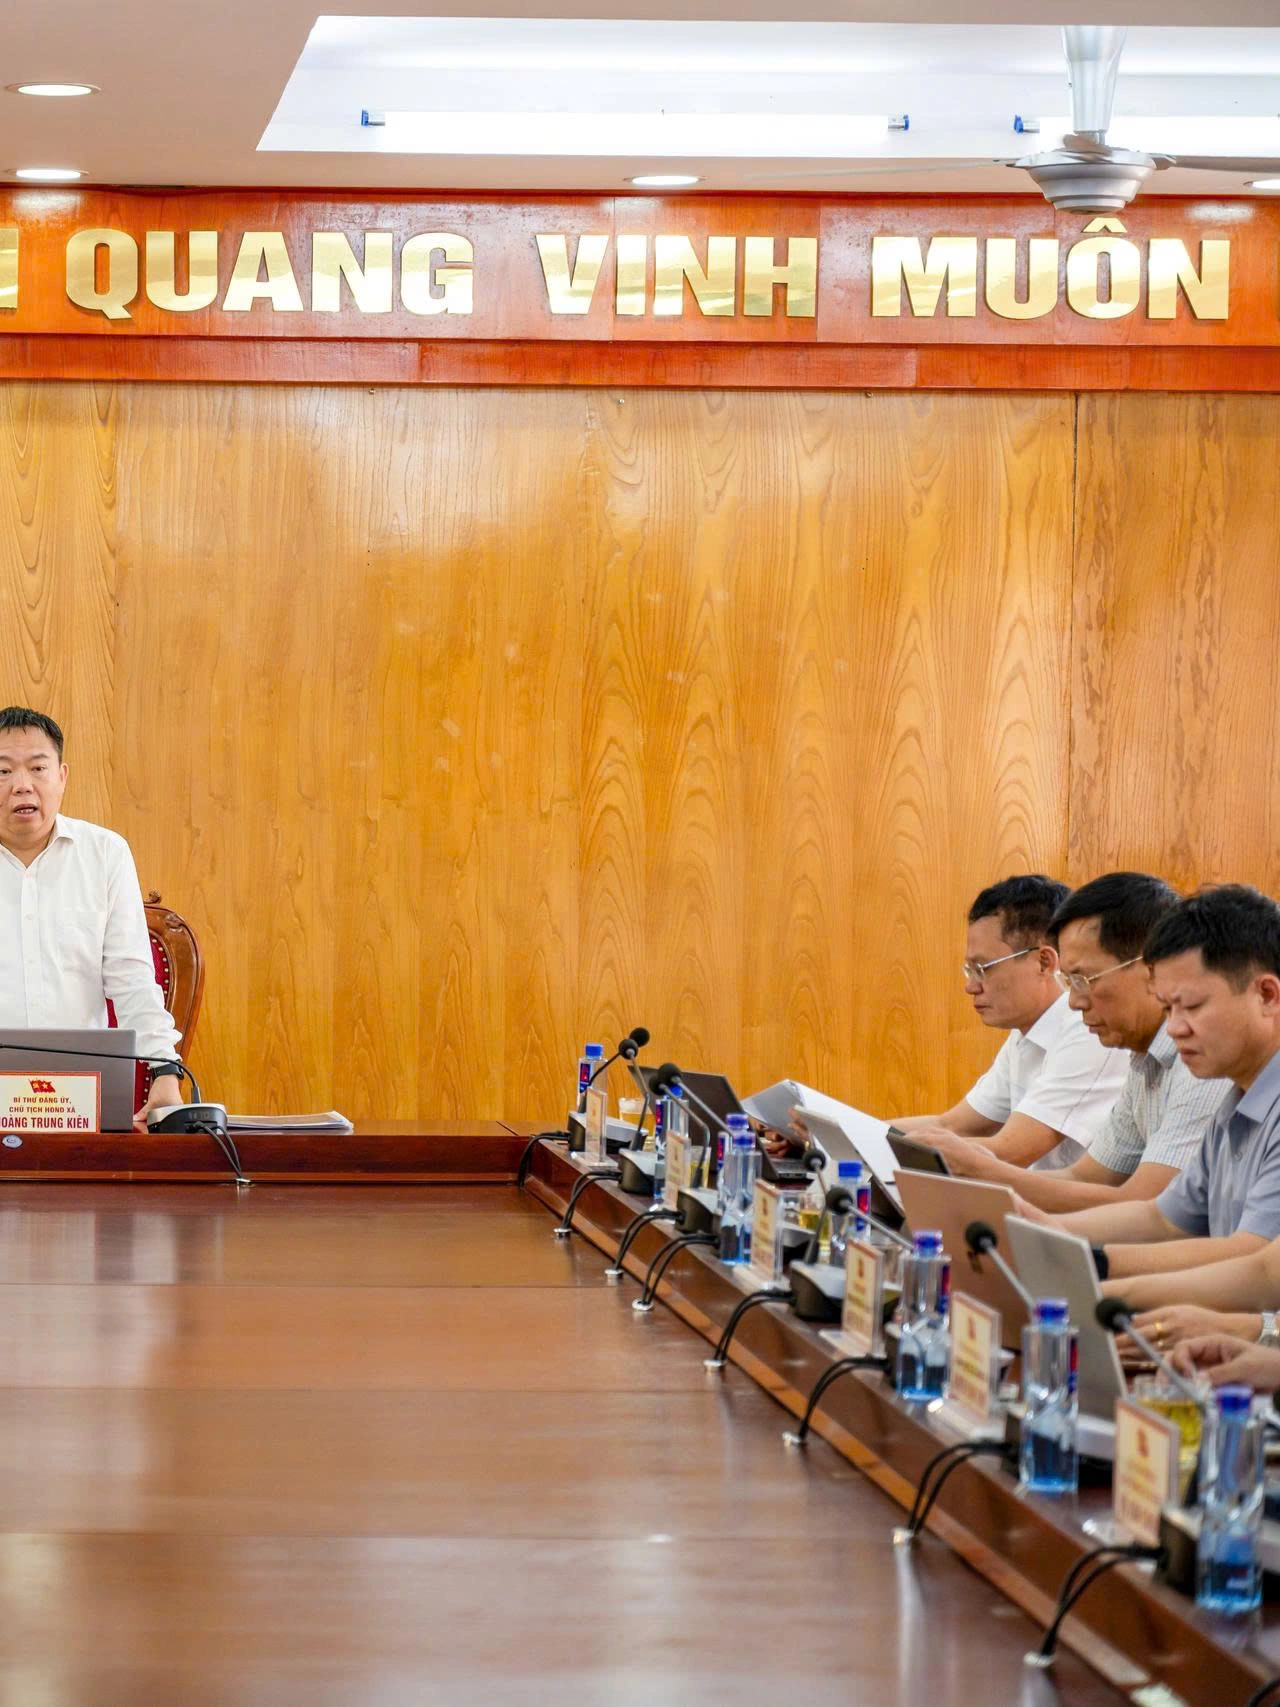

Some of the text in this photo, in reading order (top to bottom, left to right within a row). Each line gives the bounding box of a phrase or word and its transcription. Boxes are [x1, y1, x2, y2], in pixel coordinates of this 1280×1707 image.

[66, 228, 475, 320] QUANG
[535, 234, 818, 318] VINH
[871, 217, 1230, 320] MUÔN
[26, 1106, 43, 1114] TỊCH
[31, 1117, 64, 1129] TRUNG
[66, 1114, 89, 1129] KIÊN
